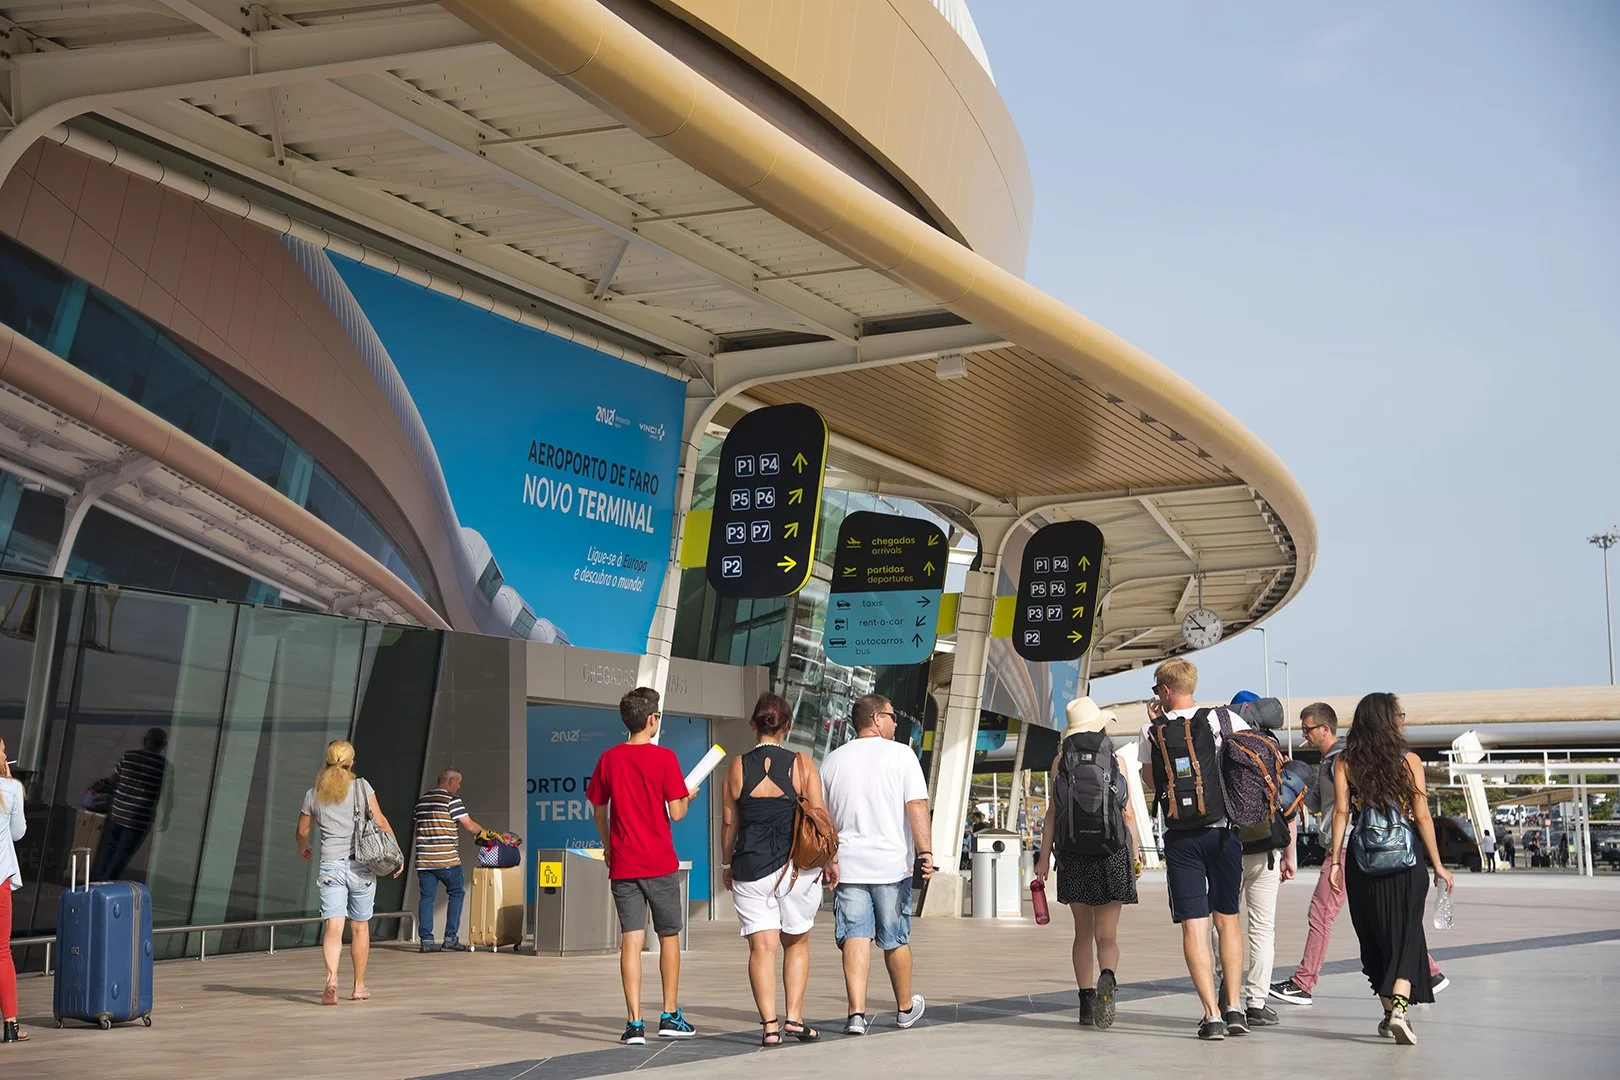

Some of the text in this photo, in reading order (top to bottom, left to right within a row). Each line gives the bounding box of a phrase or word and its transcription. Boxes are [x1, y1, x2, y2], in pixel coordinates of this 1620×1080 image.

[639, 423, 657, 435] VINCI
[528, 440, 659, 495] AEROPORTO DE FARO
[738, 457, 778, 473] P1 P4
[522, 473, 654, 534] NOVO TERMINAL
[732, 491, 774, 507] P5 P6
[728, 525, 769, 540] P3 P7
[871, 536, 916, 547] chegadas
[871, 547, 902, 555] arrivals
[587, 546, 616, 566] Ligue-se
[622, 554, 648, 573] Europa
[1036, 559, 1068, 571] P1 P4
[724, 560, 741, 573] P2
[867, 565, 905, 576] partidas
[573, 565, 646, 592] e descubra o mundo!
[867, 575, 914, 585] departures
[1031, 583, 1065, 595] P5 P6
[862, 600, 883, 608] taxis
[1028, 607, 1061, 619] P3 P7
[859, 619, 904, 627] rent-a-car
[855, 638, 904, 646] autocarros
[1025, 632, 1040, 643] P2
[582, 664, 636, 688] CHEGADAS
[527, 777, 577, 794] ORTO
